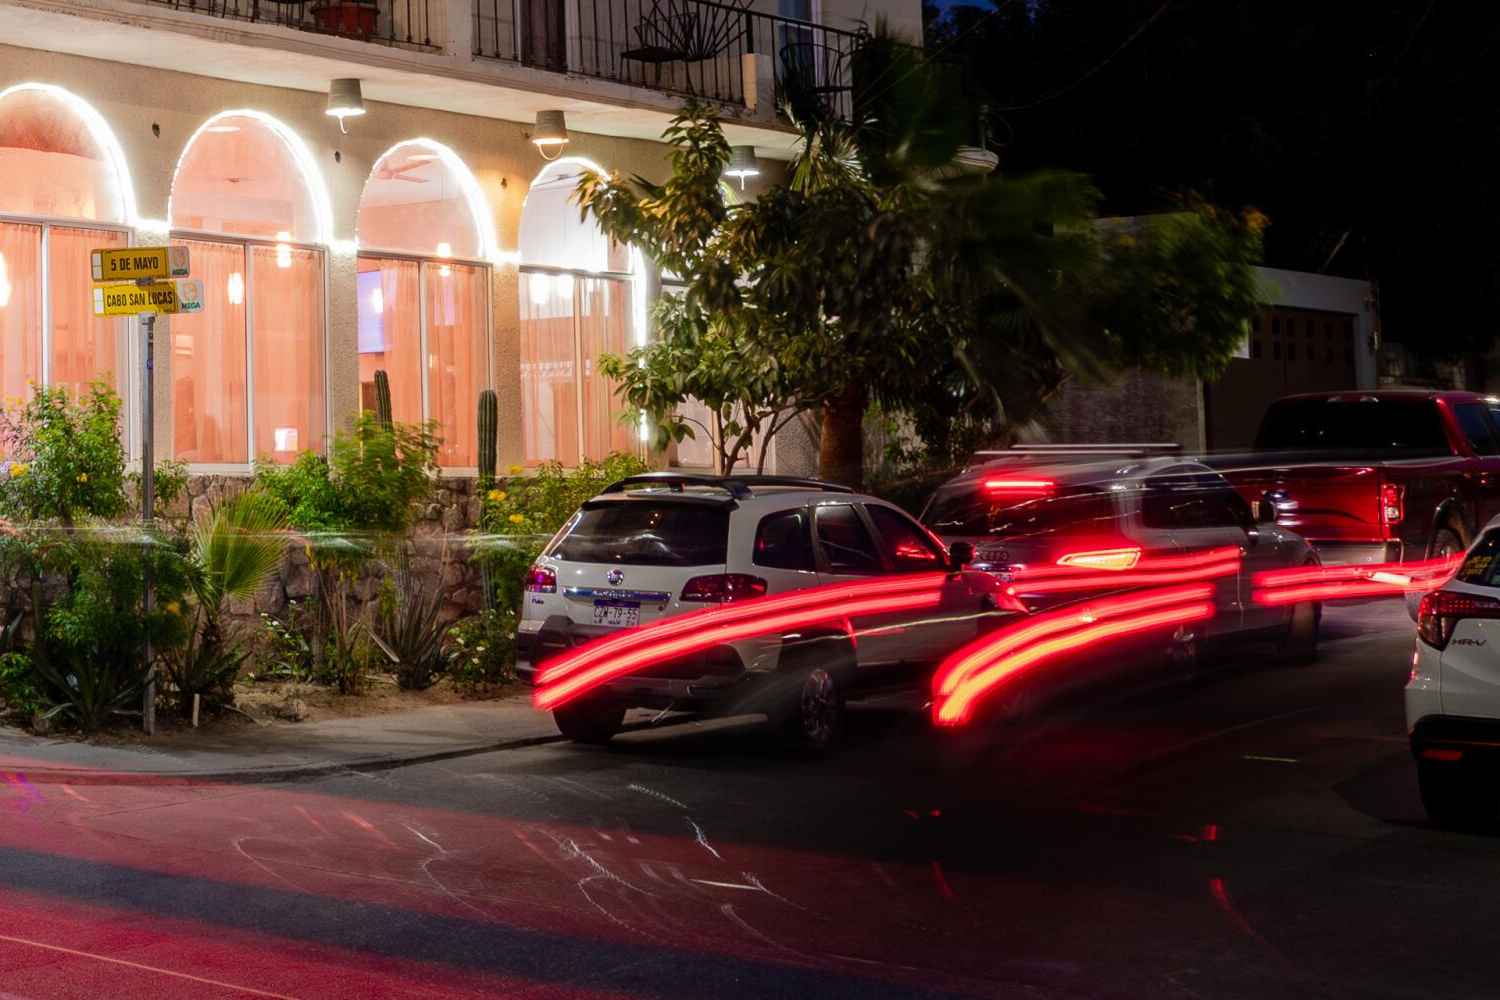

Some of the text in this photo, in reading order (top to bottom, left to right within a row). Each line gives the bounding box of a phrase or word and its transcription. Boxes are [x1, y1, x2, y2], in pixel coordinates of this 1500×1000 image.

[111, 256, 159, 271] 5 DE MAYO
[106, 290, 173, 307] CABO SAN LUCAS
[181, 301, 201, 310] MEGA
[1451, 638, 1486, 646] HR-V
